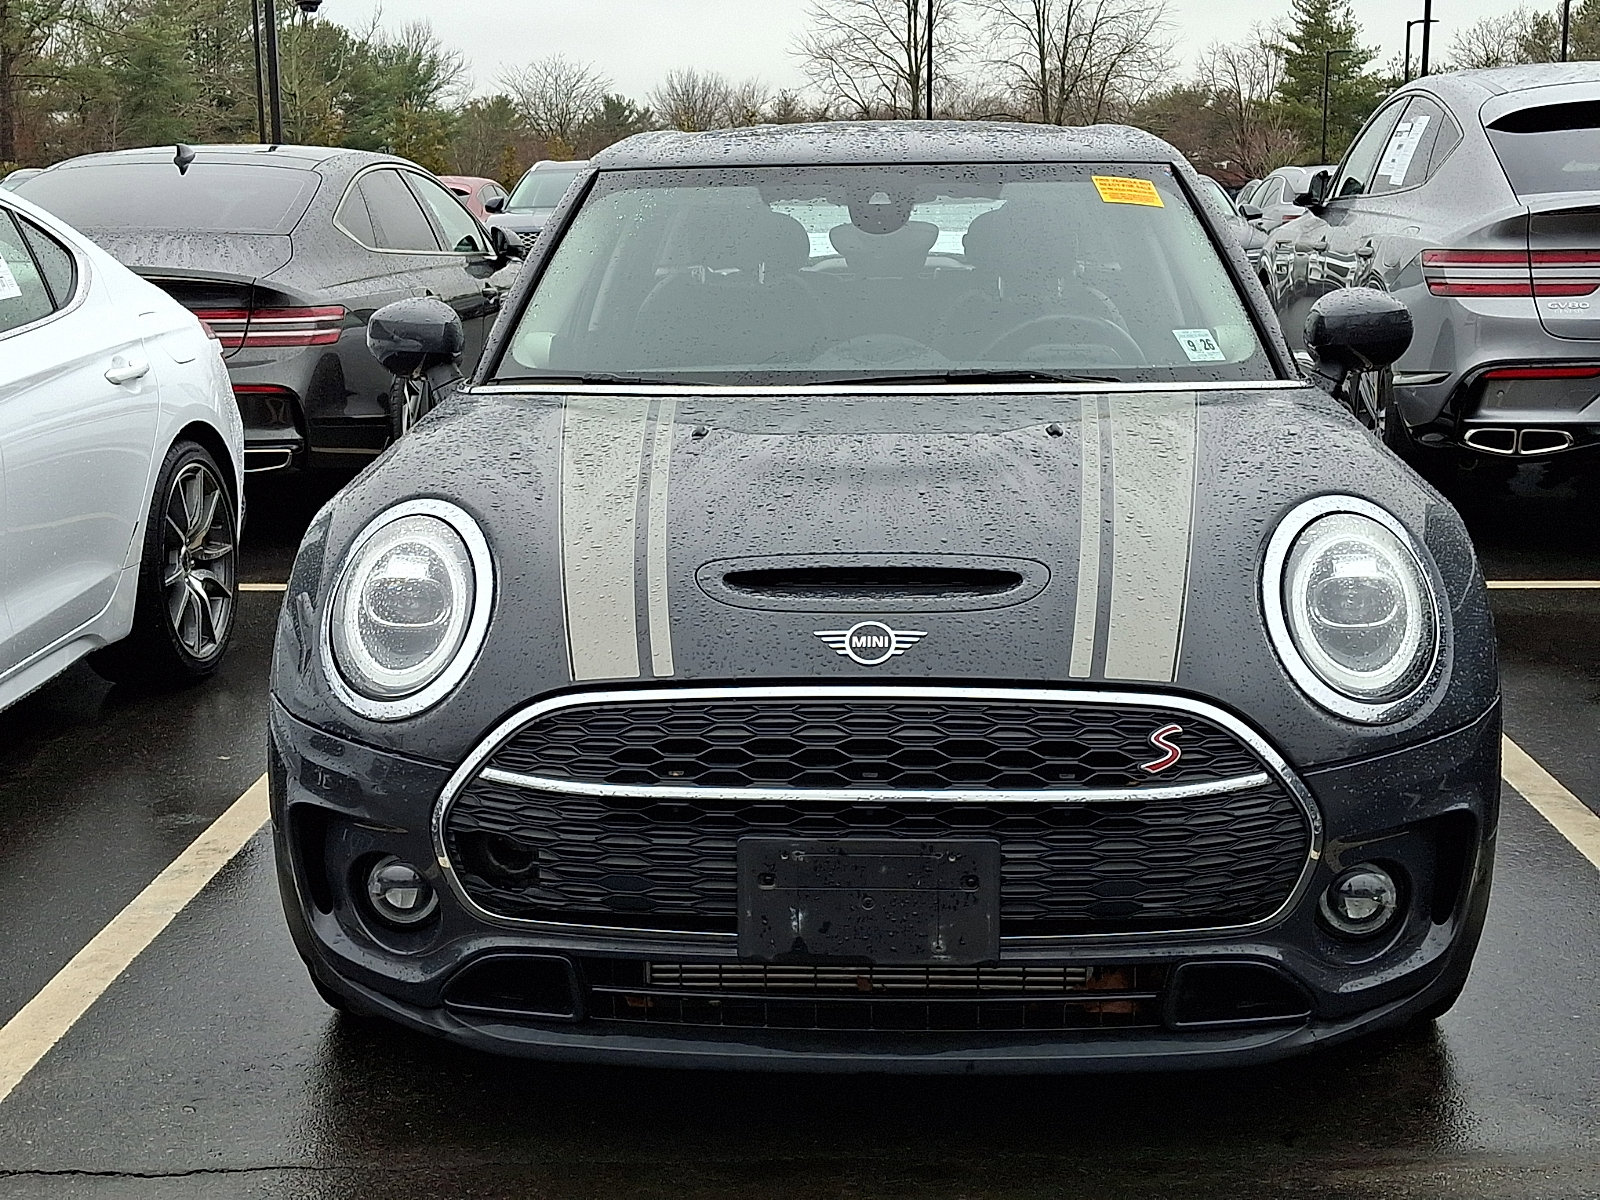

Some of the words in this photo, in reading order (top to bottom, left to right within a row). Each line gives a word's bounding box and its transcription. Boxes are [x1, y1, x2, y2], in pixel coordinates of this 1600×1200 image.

[1547, 301, 1590, 309] GV80
[1187, 340, 1197, 351] 9
[1200, 339, 1215, 350] 26
[851, 635, 889, 648] MINI
[1140, 724, 1183, 773] S
